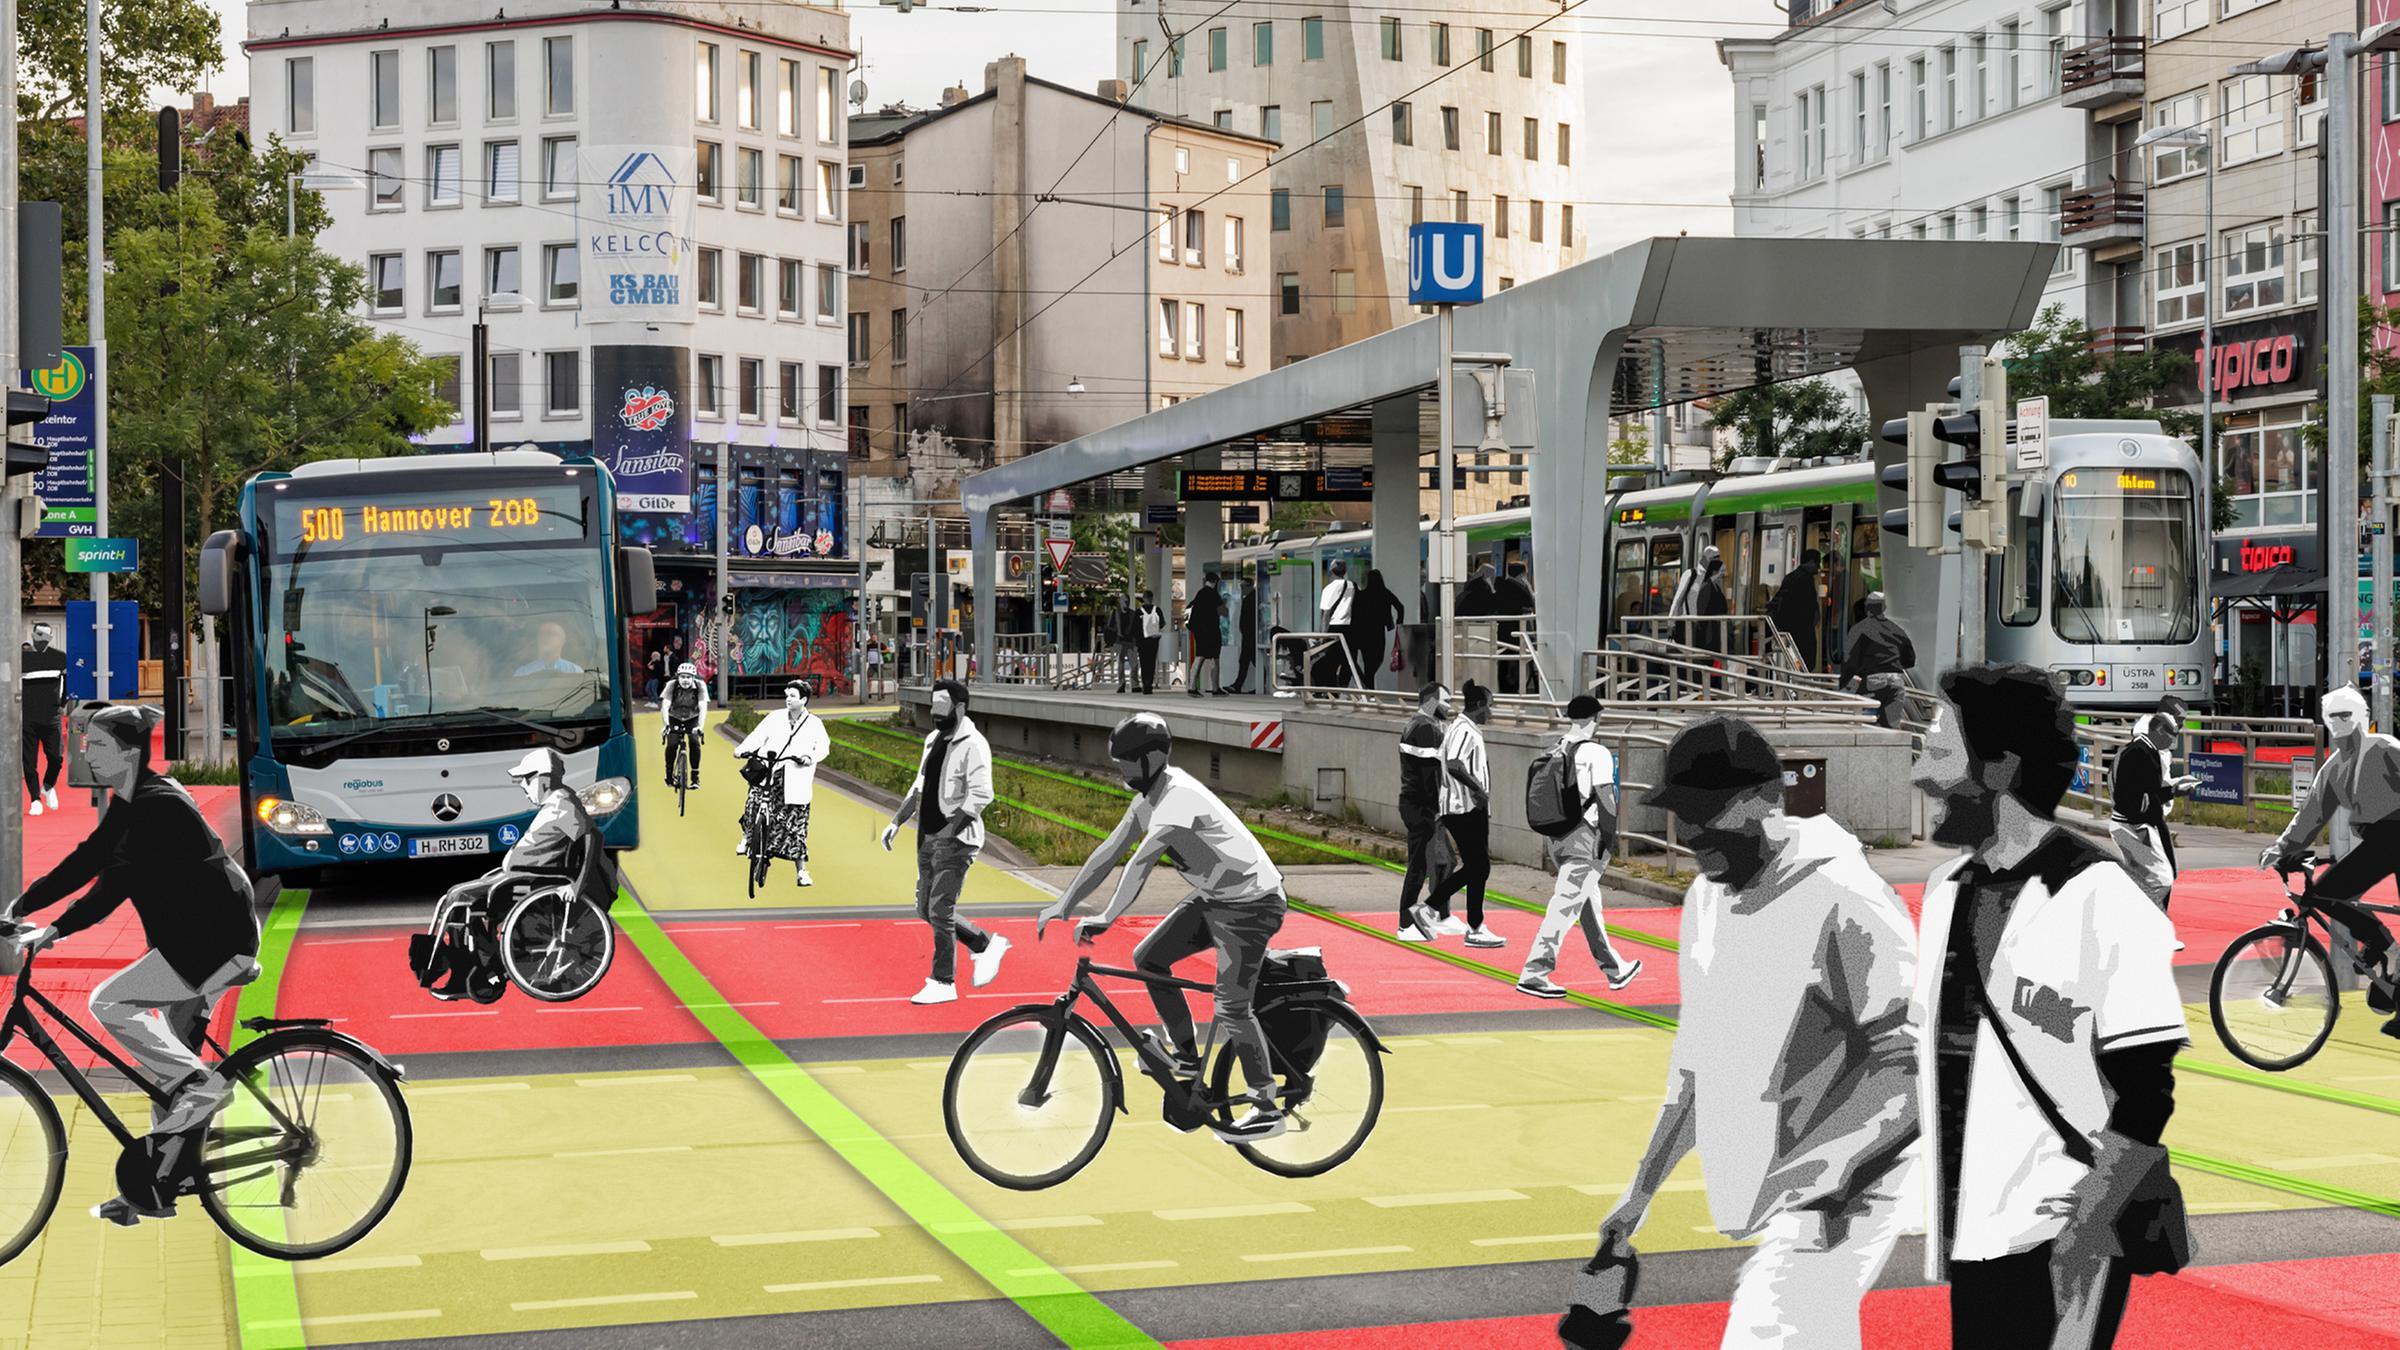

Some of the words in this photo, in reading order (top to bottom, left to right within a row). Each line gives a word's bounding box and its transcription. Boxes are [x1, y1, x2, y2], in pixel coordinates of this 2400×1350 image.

[1411, 234, 1422, 291] U
[1433, 233, 1475, 290] U
[610, 274, 637, 289] KS
[643, 274, 679, 289] BAU
[610, 289, 679, 305] GMBH
[40, 415, 77, 424] teintor
[628, 411, 650, 425] TRUE
[652, 400, 671, 414] LOVE
[604, 445, 684, 475] Sansibar
[2064, 474, 2077, 488] 10
[2117, 475, 2155, 489] Ahlem
[639, 497, 675, 509] Gilde
[45, 512, 67, 520] one
[69, 510, 77, 520] A
[302, 507, 344, 542] 500
[364, 506, 472, 533] Hannover
[489, 498, 539, 527] ZOB
[69, 525, 93, 535] GVH
[78, 550, 126, 562] sprintH
[2240, 538, 2293, 573] tipico
[2121, 621, 2128, 630] 5
[2123, 666, 2156, 678] ÜSTRA
[343, 779, 384, 790] regiobus
[421, 839, 430, 853] H
[439, 839, 456, 852] RH
[458, 837, 483, 851] 302
